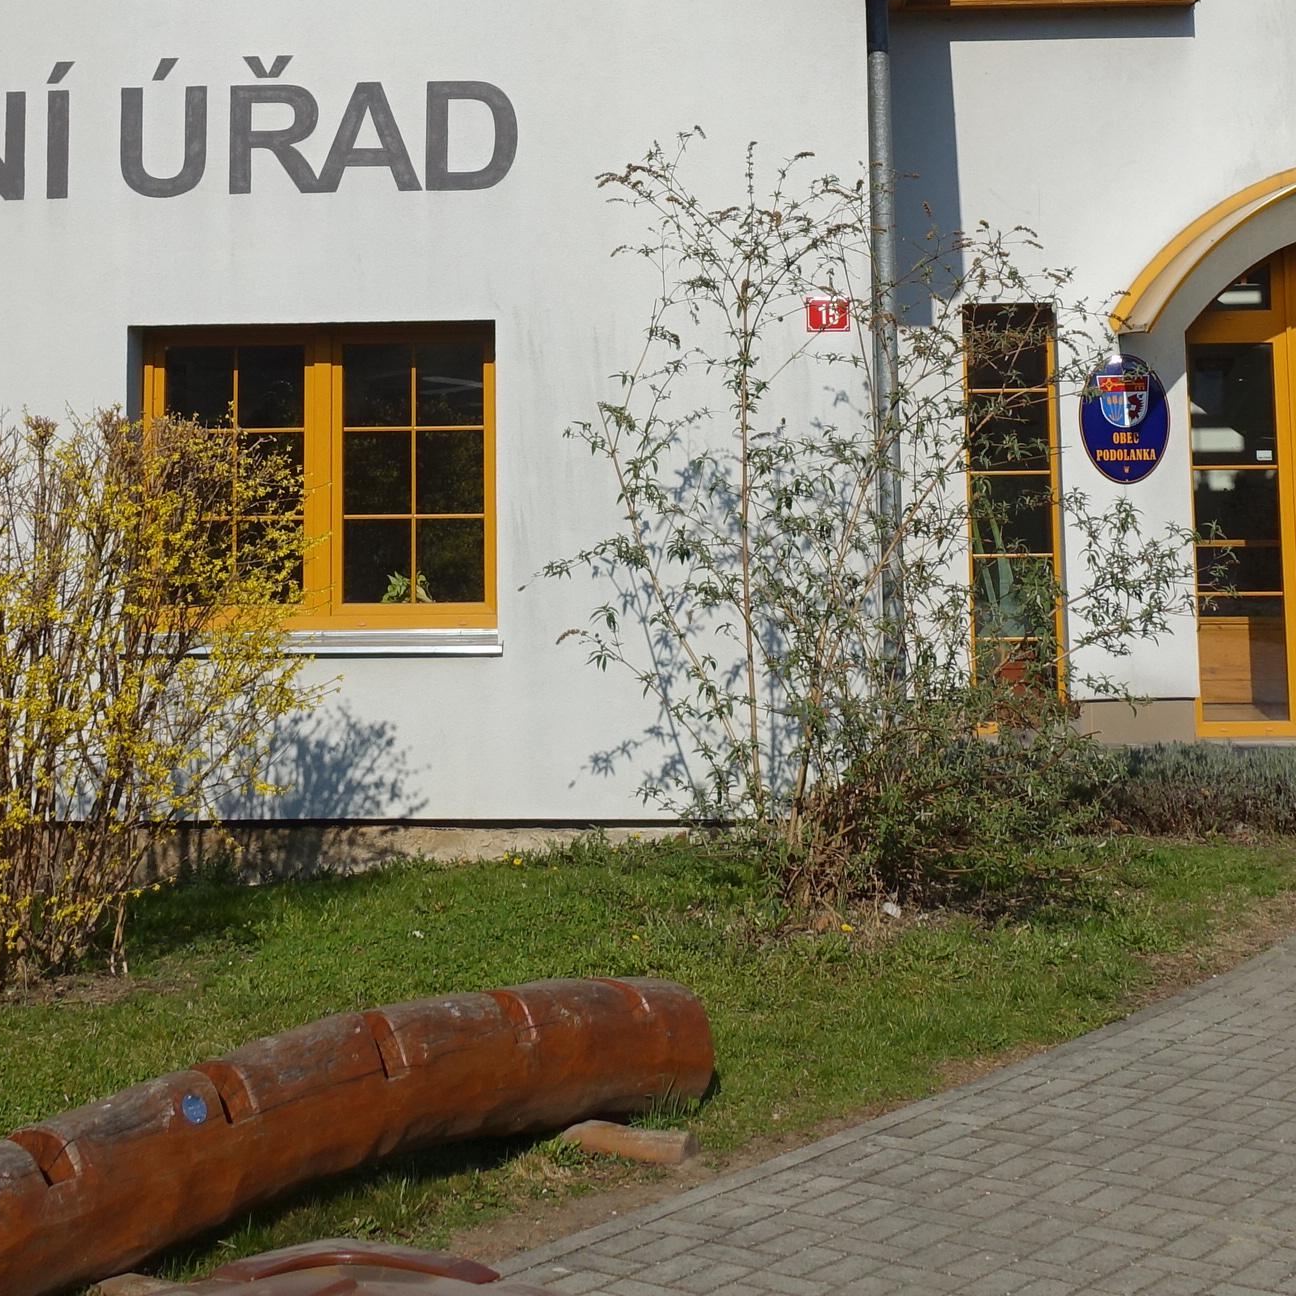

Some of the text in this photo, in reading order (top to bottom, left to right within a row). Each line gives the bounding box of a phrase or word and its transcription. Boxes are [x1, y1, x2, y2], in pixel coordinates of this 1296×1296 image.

[118, 54, 519, 200] ÚŘAD
[1112, 431, 1140, 444] OBEC
[1095, 448, 1157, 461] PODOLANKA
